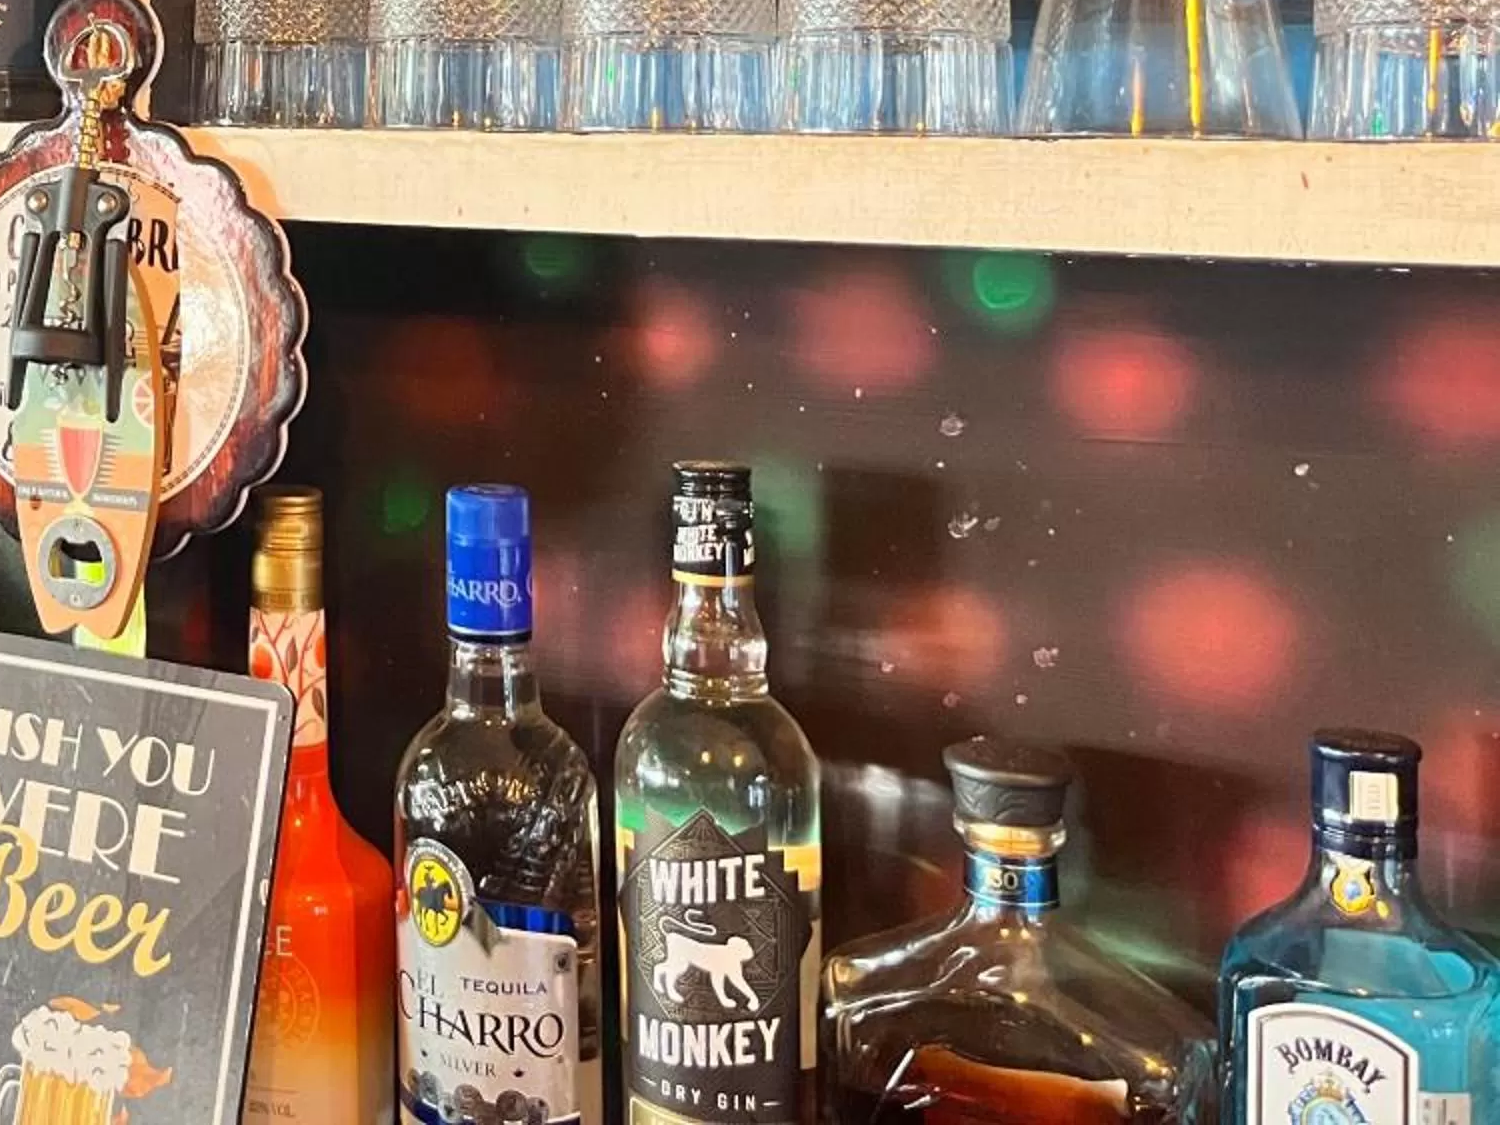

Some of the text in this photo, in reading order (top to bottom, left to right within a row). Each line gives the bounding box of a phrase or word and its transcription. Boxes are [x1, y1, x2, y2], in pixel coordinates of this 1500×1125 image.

[97, 726, 216, 797] YOU
[649, 854, 766, 905] WHITE
[400, 967, 565, 1059] CHARRO
[460, 976, 548, 997] TEQUILA
[638, 1012, 782, 1069] MONKEY
[1273, 1036, 1387, 1094] BOMBAY
[660, 1078, 757, 1112] DRY GIN
